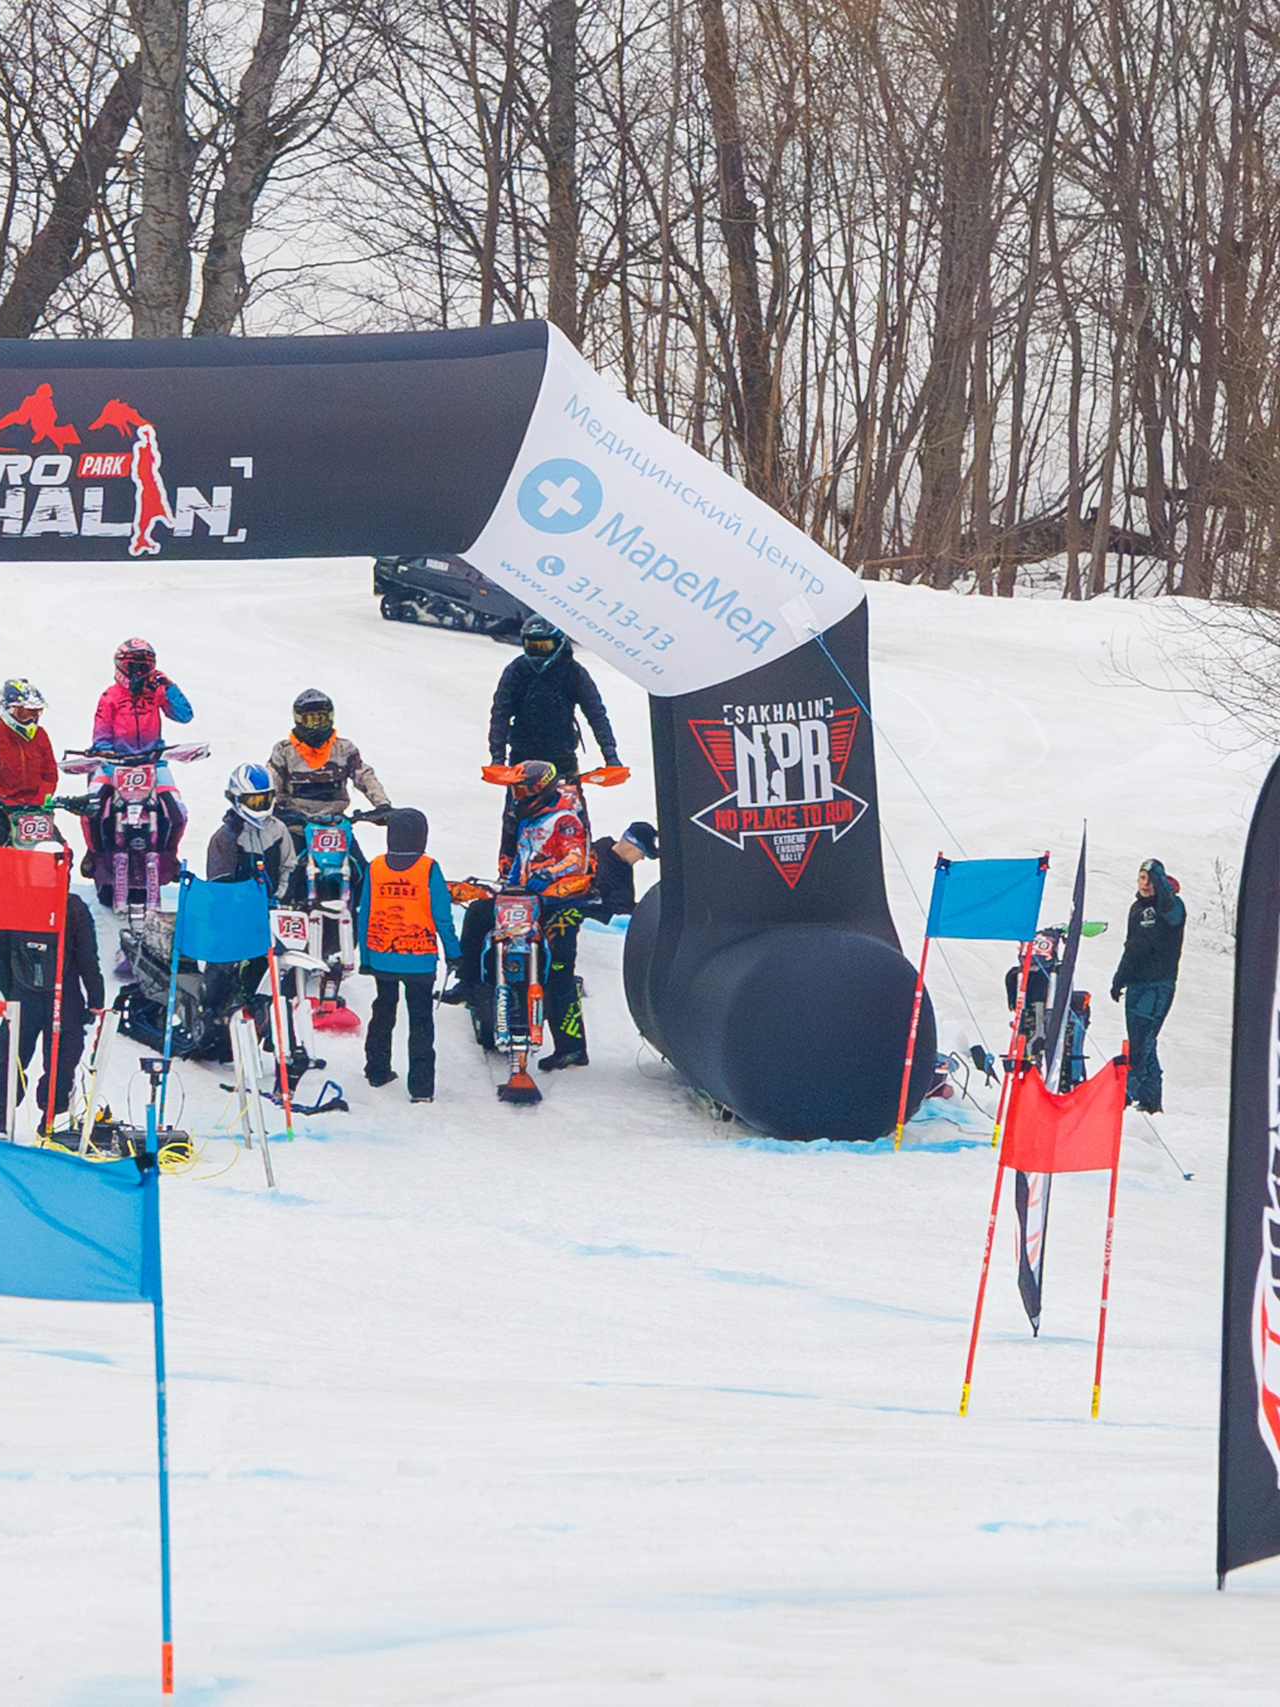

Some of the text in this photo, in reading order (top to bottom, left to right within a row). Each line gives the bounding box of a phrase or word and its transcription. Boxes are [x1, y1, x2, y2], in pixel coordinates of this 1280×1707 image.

[80, 455, 124, 477] PARK
[564, 393, 825, 596] Медицинский Центр
[595, 512, 778, 654] МареМед
[500, 558, 664, 677] www.maremed.ru
[567, 576, 676, 653] 31-13-13
[734, 699, 825, 724] SAKHALIN
[733, 719, 833, 807] NPR
[124, 772, 145, 787] 10
[22, 822, 49, 835] 03
[715, 800, 854, 831] NO PLACE TO RUN
[320, 834, 340, 847] 01
[285, 921, 302, 934] 12
